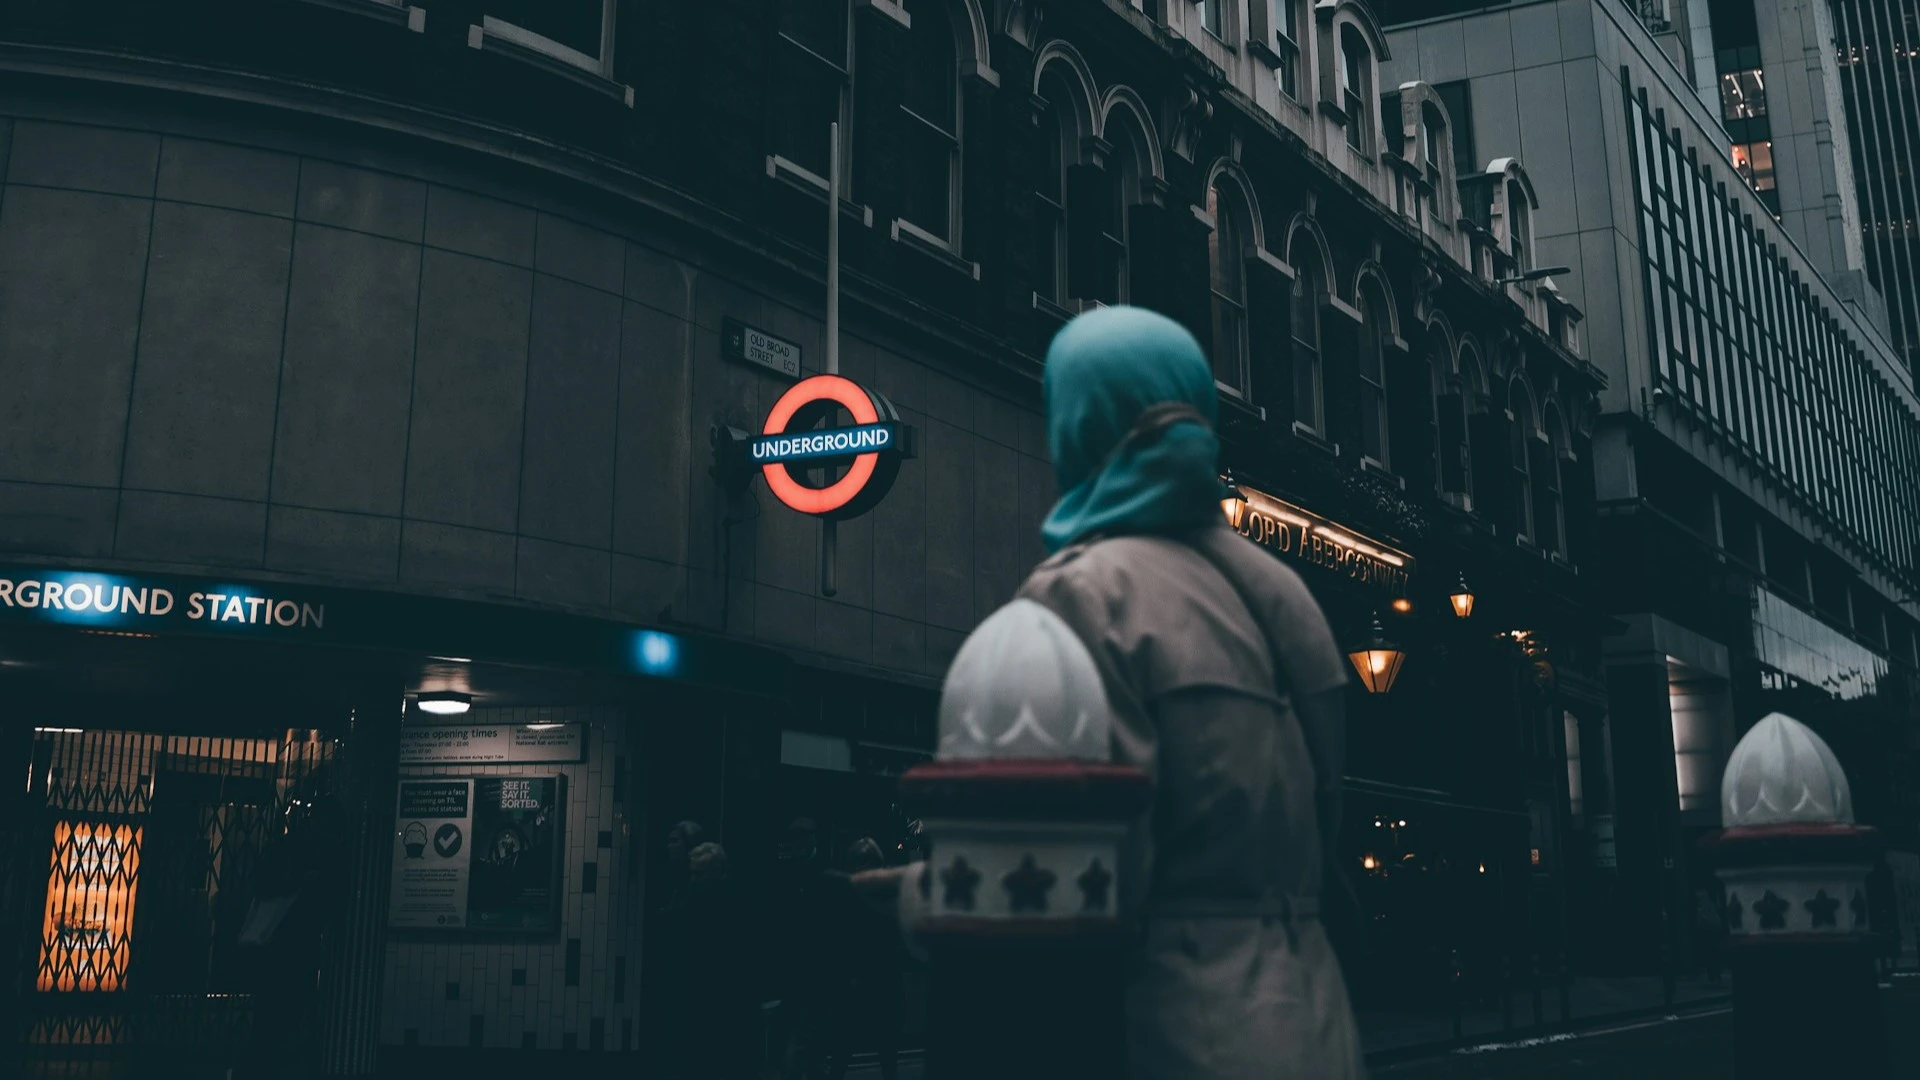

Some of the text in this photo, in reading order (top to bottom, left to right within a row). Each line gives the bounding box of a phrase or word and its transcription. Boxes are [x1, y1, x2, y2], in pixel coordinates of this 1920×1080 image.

[751, 334, 789, 357] OLD BROAD
[751, 347, 796, 372] STREET EC2
[752, 429, 889, 459] UNDERGROUND
[186, 591, 325, 629] STATION
[432, 729, 468, 740] opening
[471, 728, 498, 738] times
[502, 781, 530, 790] SEE IT.
[453, 788, 465, 796] face
[502, 790, 530, 799] SAY IT.
[501, 799, 540, 809] SORTED.
